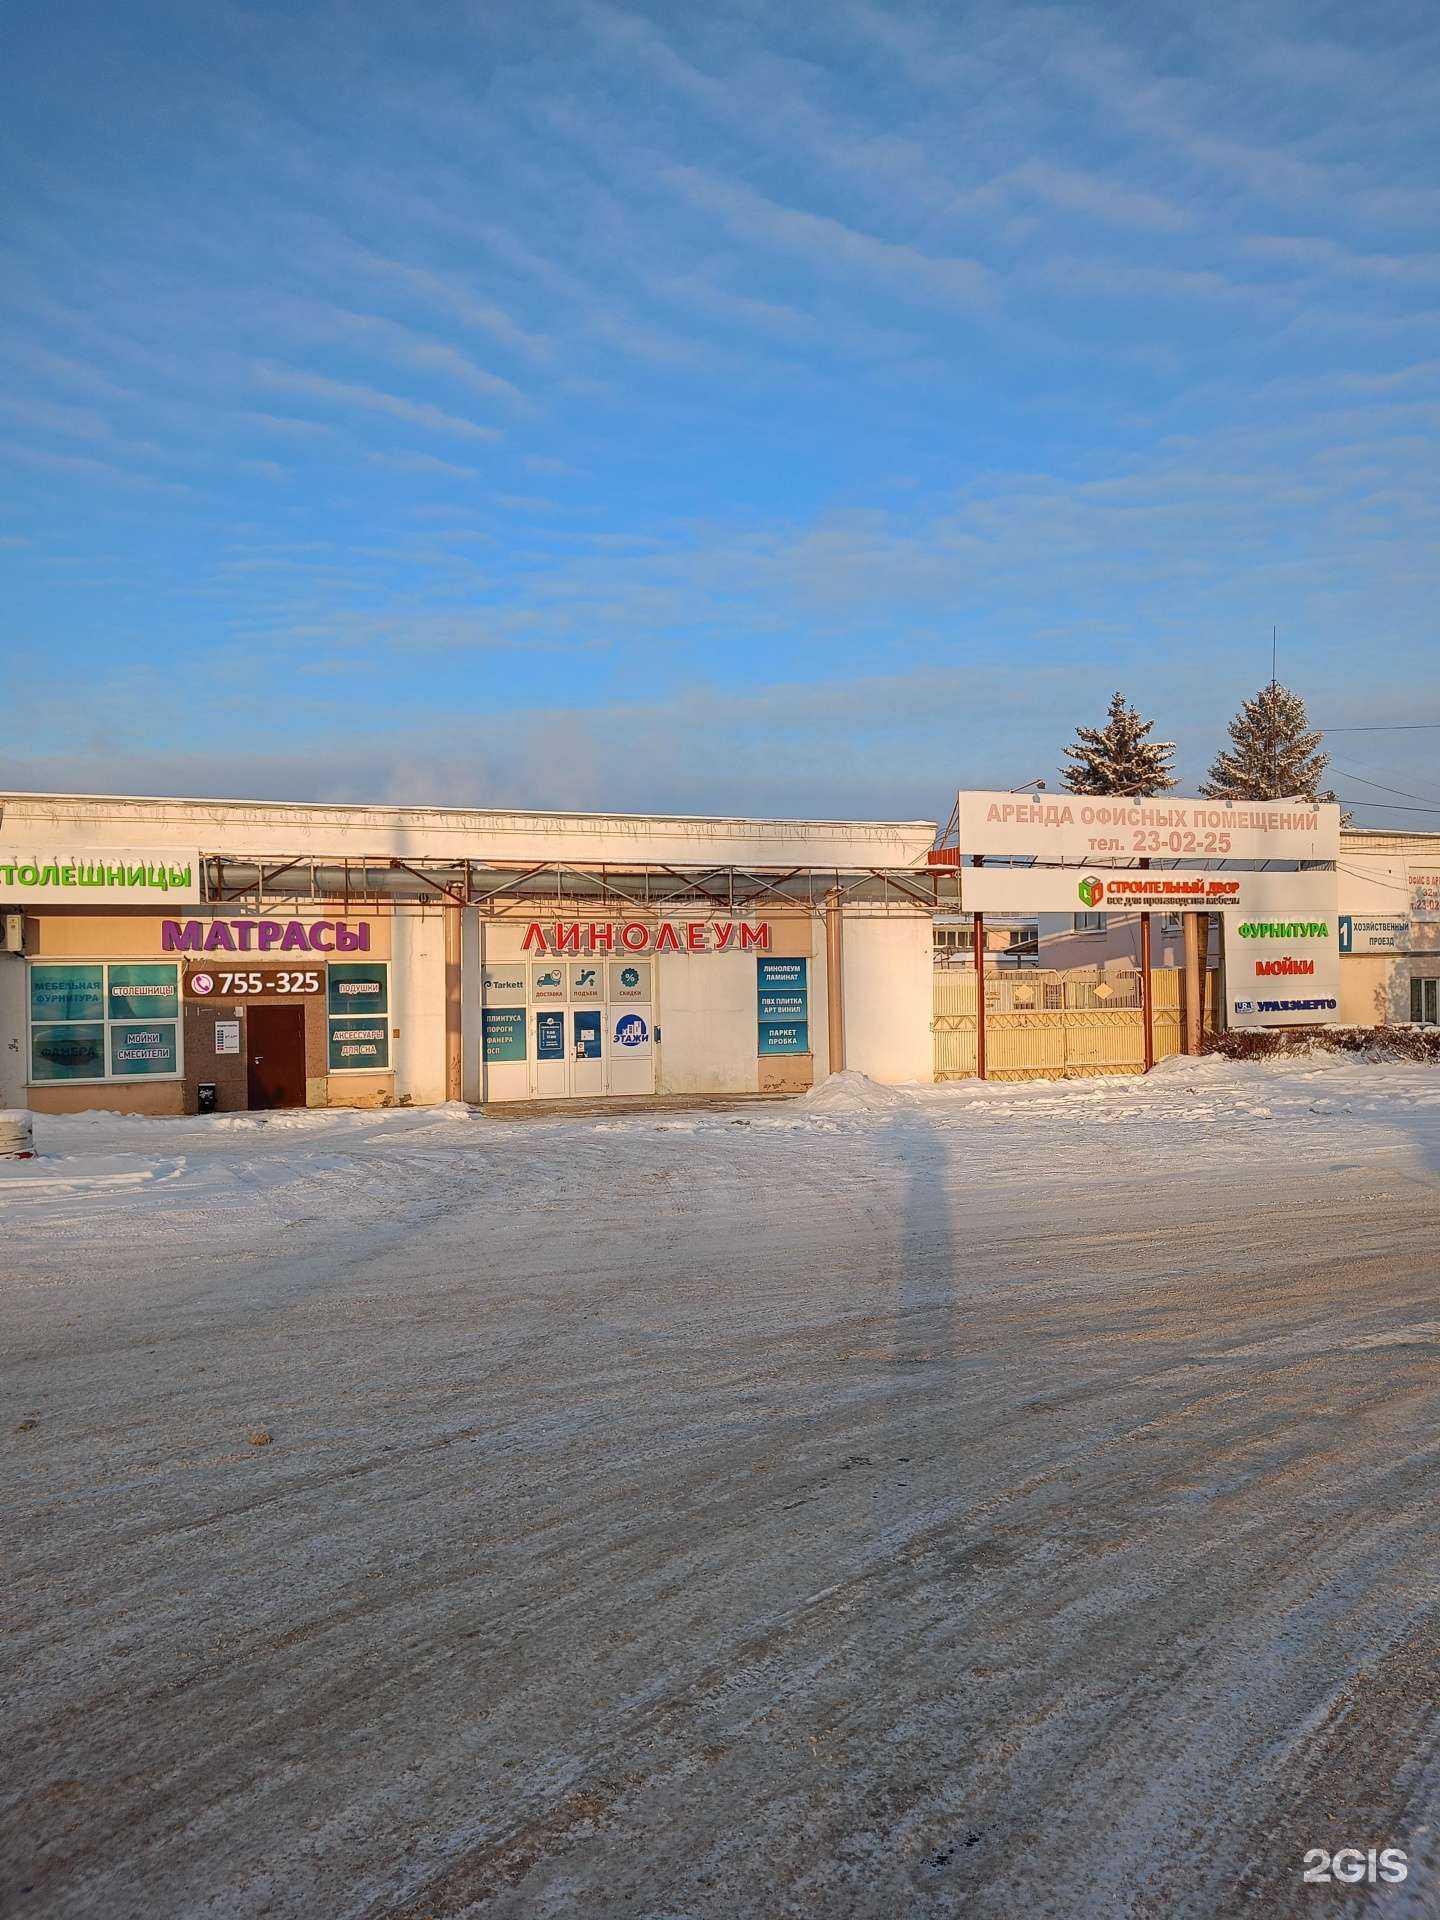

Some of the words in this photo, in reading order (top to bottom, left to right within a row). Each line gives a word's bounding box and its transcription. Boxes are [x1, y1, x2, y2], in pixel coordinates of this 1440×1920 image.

[987, 804, 1074, 827] АРЕНДА
[1081, 806, 1187, 828] ОФИСНЫХ
[1194, 808, 1319, 832] ПОМЕЩЕНИЙ
[1088, 837, 1125, 851] тел.
[1133, 830, 1232, 853] 23-02-25
[0, 864, 191, 891] ТОЛЕШНИЦЫ
[1408, 876, 1424, 885] ОФИС
[1107, 879, 1205, 893] СТРОИТЕЛЬНЫЙ
[1206, 882, 1240, 896] ДВОР
[1238, 922, 1329, 938] ФУРНИТУРА
[1353, 921, 1409, 932] ХОЗЯЙСТВЕННЫЙ
[162, 920, 371, 951] МАТРАСЫ
[521, 922, 769, 951] ЛИНОЛЕУМ
[1340, 922, 1348, 946] 1
[1369, 937, 1395, 946] ПРОЕЗД
[1255, 957, 1314, 976] МОЙКИ
[35, 981, 100, 991] МЕБЕЛЬНАЯ
[218, 972, 319, 994] 755-325
[493, 981, 523, 989] Tarkett
[112, 985, 174, 997] СТОЛЕШНИЦЫ
[339, 984, 379, 994] ПОДУШКИ
[35, 993, 99, 1003] ФУРНИТУРА
[128, 1032, 160, 1044] МОЙКИ
[333, 1030, 384, 1041] АКСЕССУАРЫ
[613, 1034, 649, 1043] ЭТАЖИ
[769, 1029, 797, 1037] ПАРКЕТ
[487, 1036, 513, 1044] ФАНЕРА
[41, 1047, 96, 1057] ФАНЕРА
[118, 1048, 170, 1060] СМЕСИТЕЛИ
[341, 1046, 359, 1056] ДЛЯ
[360, 1045, 377, 1055] СНА
